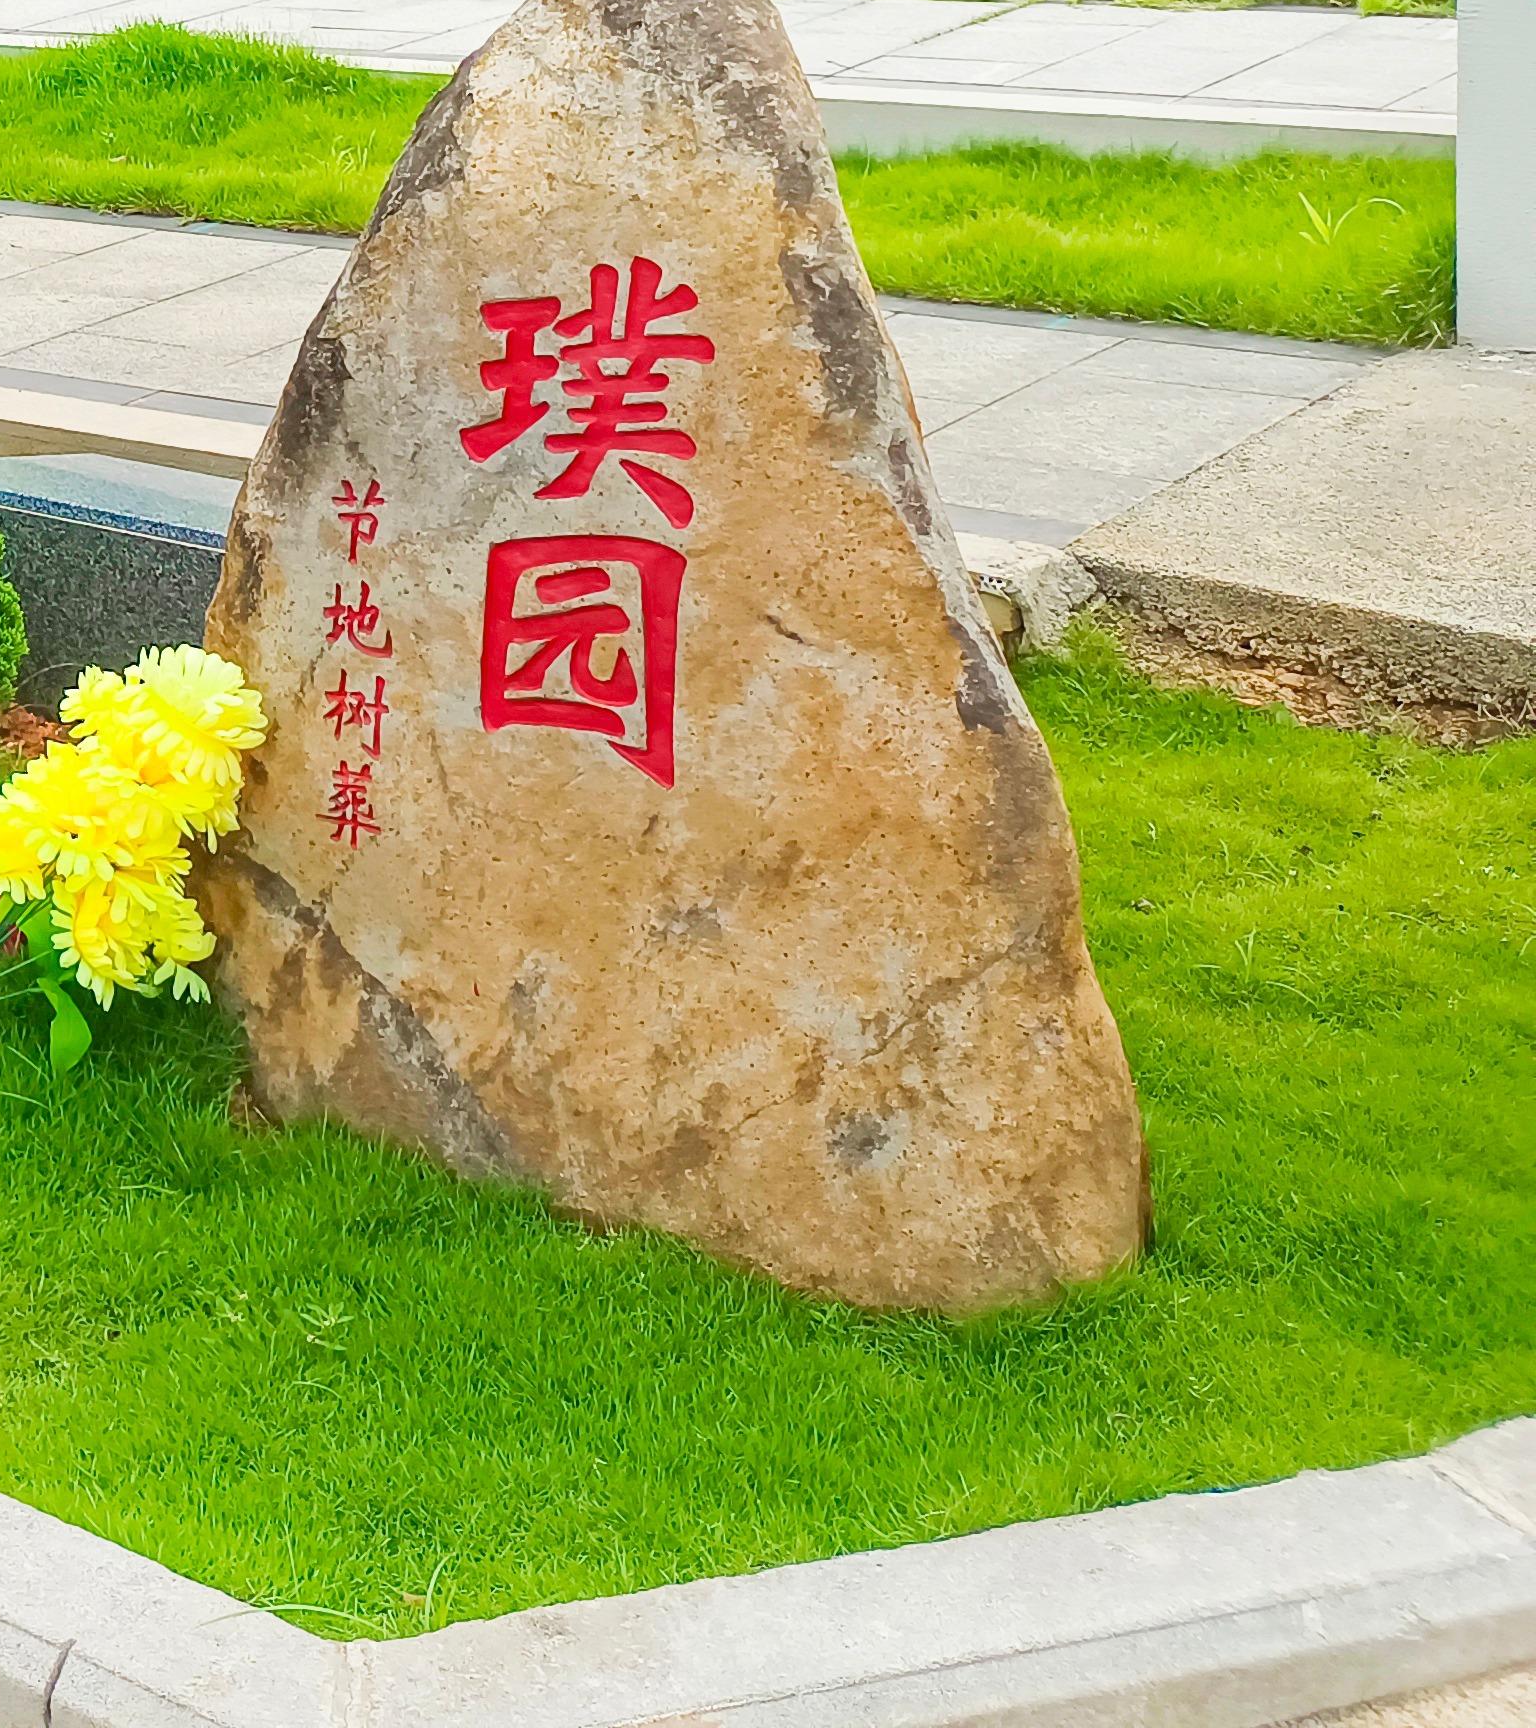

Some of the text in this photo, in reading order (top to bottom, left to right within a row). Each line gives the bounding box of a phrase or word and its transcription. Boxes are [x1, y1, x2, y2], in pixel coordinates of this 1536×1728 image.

[315, 478, 393, 850] 节地树葬
[459, 255, 715, 790] 璞园
